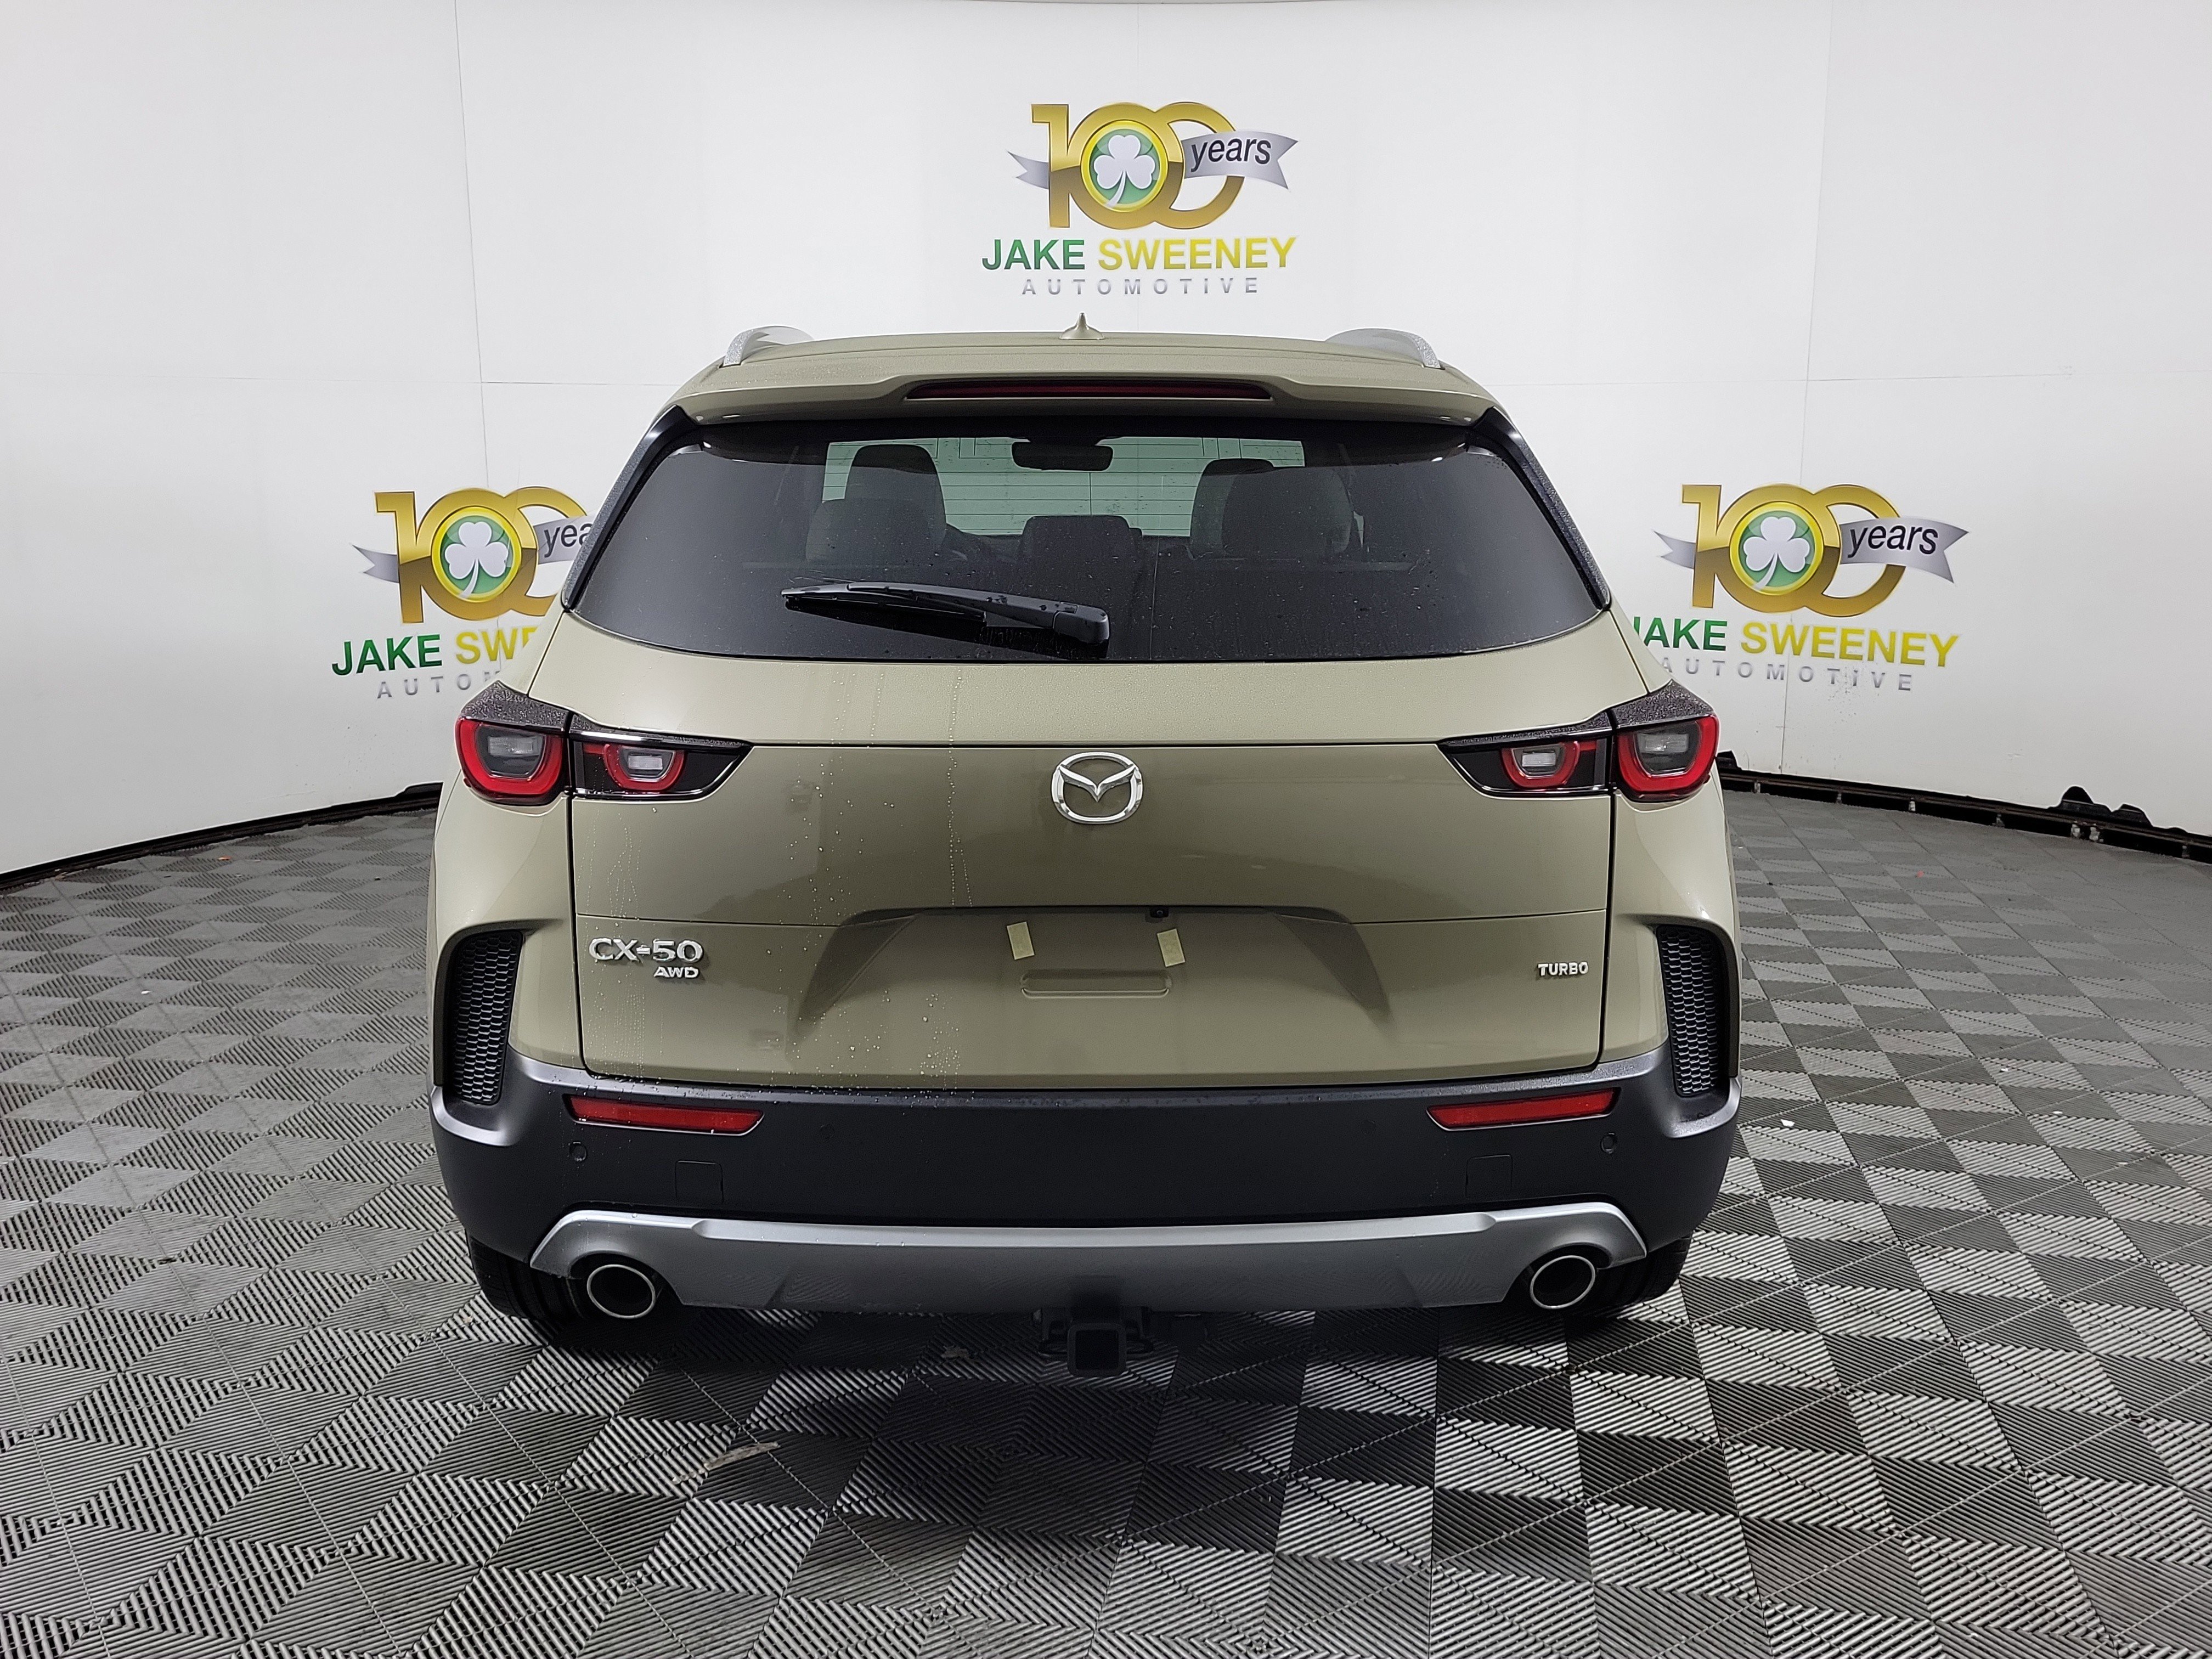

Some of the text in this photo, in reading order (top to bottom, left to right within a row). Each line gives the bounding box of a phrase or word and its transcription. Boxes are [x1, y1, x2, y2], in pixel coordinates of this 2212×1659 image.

[1190, 138, 1272, 172] years
[982, 236, 1296, 270] JAKE SWEENEY
[1022, 277, 1257, 295] AUTOMOTIVE
[1848, 524, 1938, 558] years
[331, 634, 442, 676] JAKE
[1741, 622, 1959, 667] SWEENEY
[377, 670, 500, 699] AUTO
[1662, 657, 1912, 691] AUTOMOTIVE
[589, 938, 703, 962] CX-50
[654, 967, 699, 978] AWD
[1538, 962, 1588, 976] TURBO
